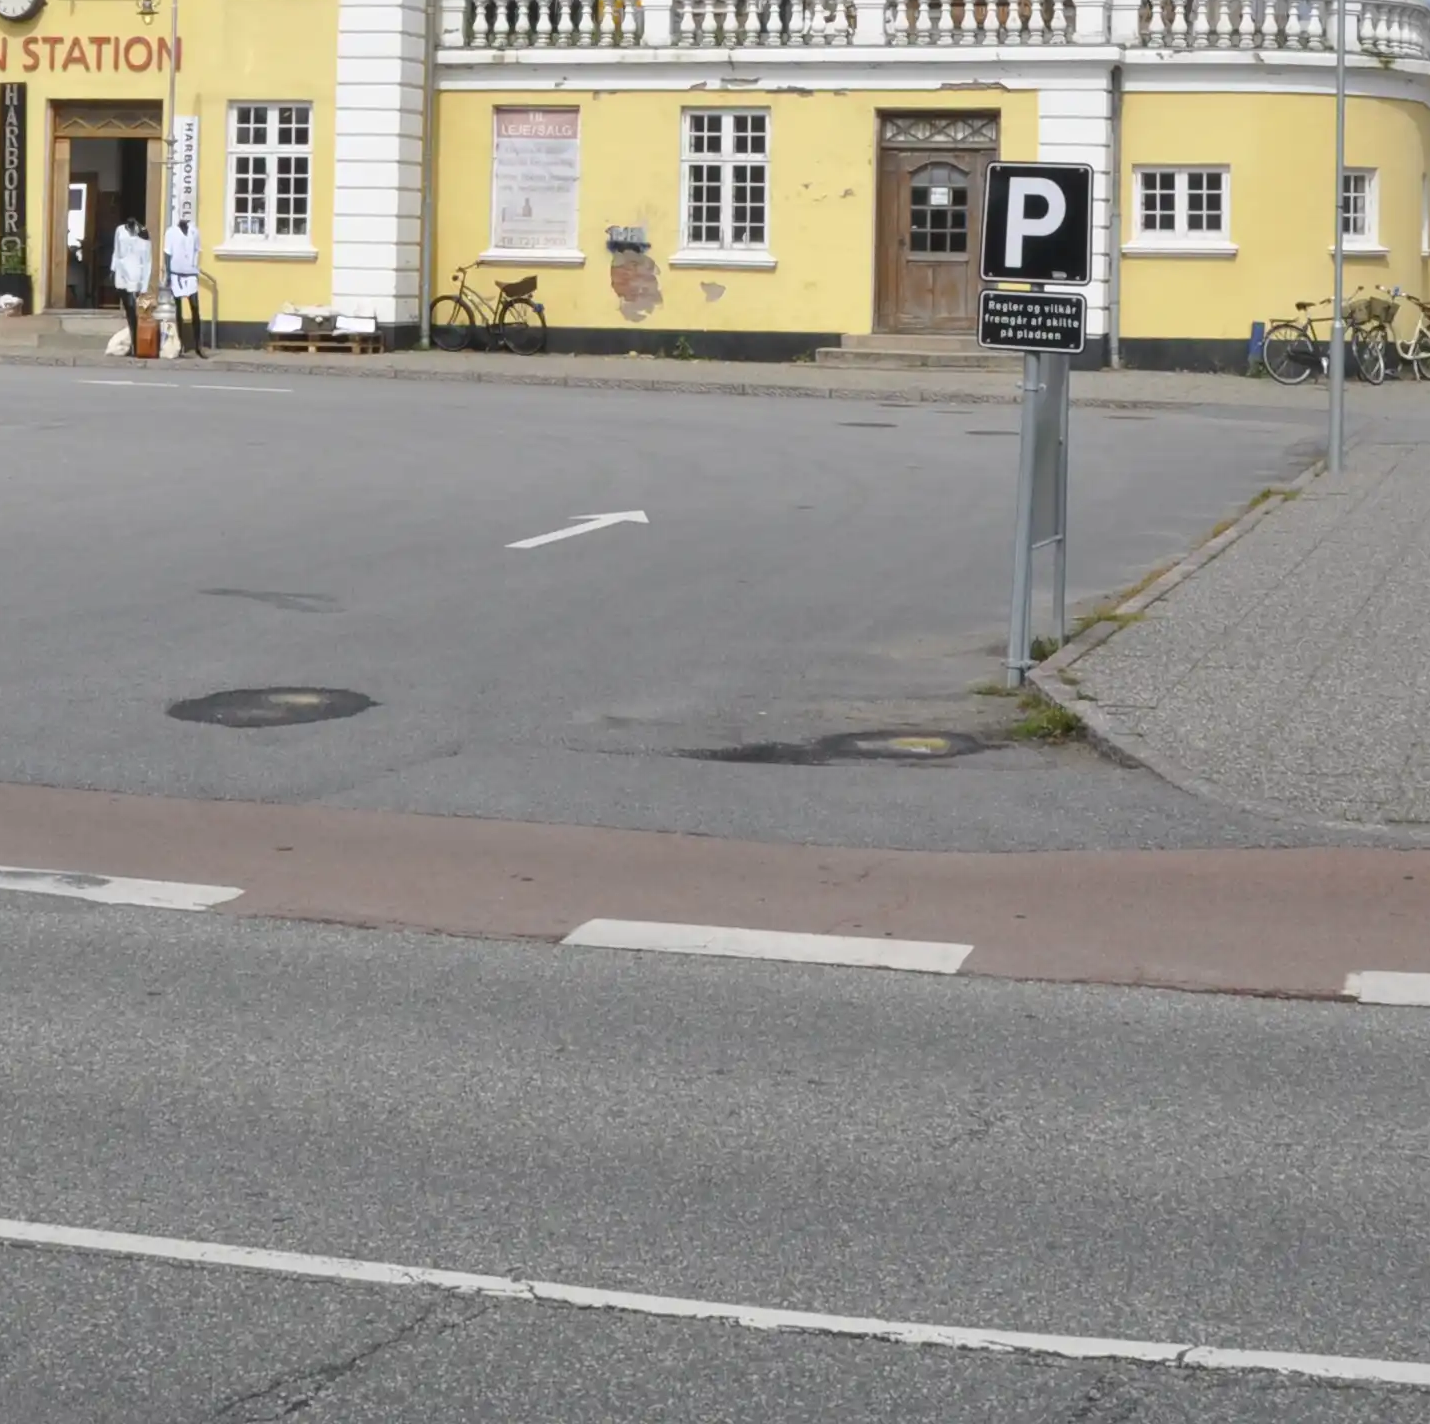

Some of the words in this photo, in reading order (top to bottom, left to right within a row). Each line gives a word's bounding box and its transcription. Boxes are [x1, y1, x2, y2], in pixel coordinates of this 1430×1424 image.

[22, 35, 184, 73] STATION
[528, 112, 545, 123] TIL
[501, 124, 573, 137] LEJE/SALG
[4, 83, 19, 233] HARBOUR
[183, 122, 194, 194] HARBOUR
[182, 201, 191, 225] CL
[1004, 176, 1067, 269] P
[987, 300, 1024, 313] Regler
[1026, 304, 1041, 314] og
[1043, 303, 1077, 315] vilkår
[984, 313, 1028, 326] fremgår
[1030, 317, 1043, 326] af
[1045, 318, 1080, 329] skilte
[1000, 328, 1014, 339] på
[1016, 328, 1062, 341] pladsen
